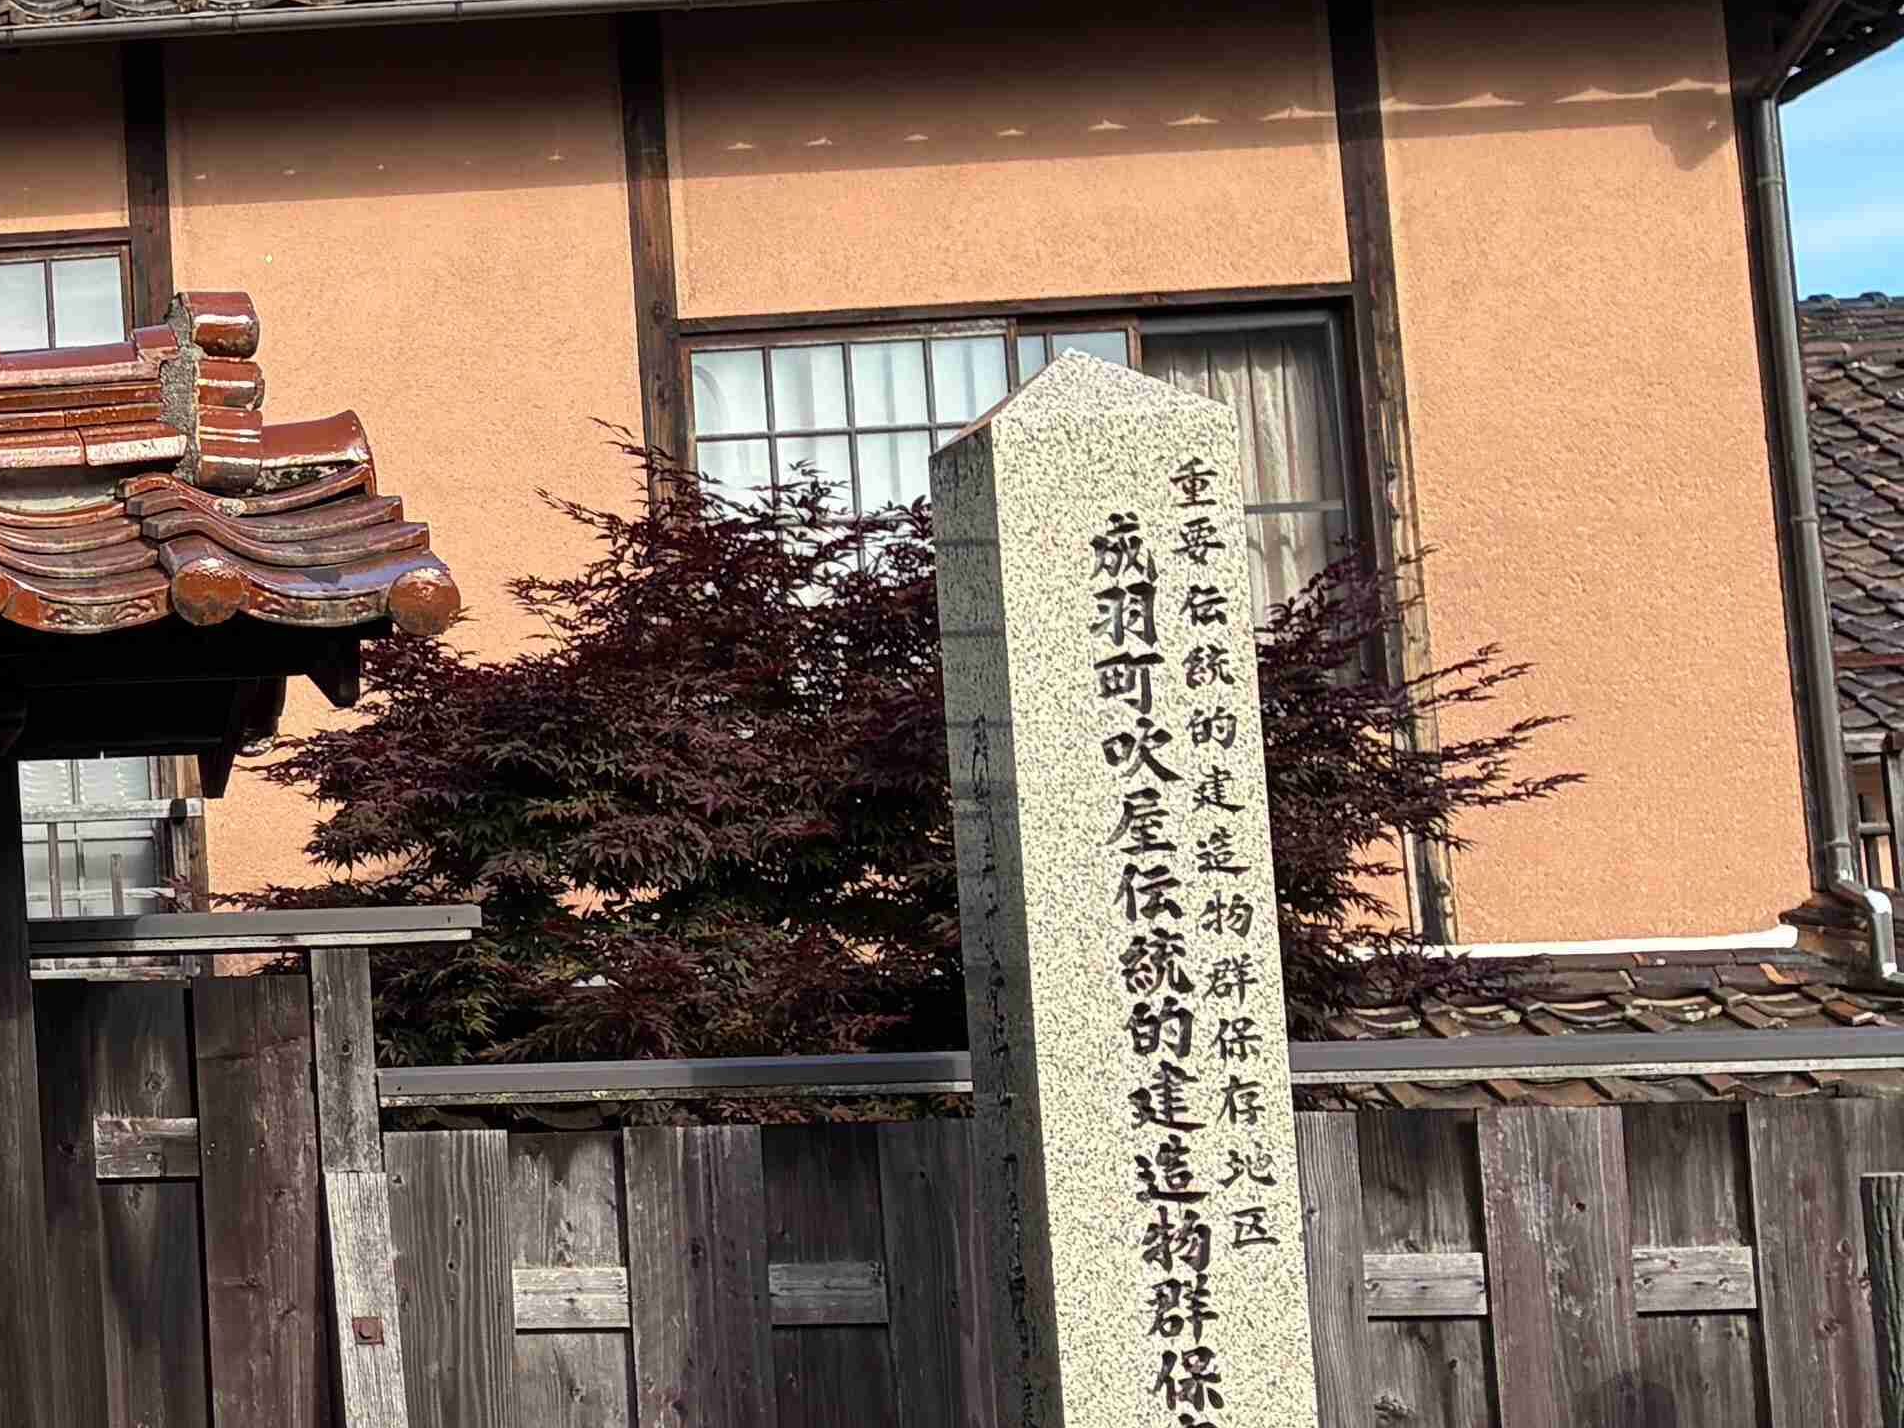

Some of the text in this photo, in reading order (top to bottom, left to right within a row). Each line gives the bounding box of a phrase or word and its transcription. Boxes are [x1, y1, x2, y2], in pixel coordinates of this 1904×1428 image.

[1169, 455, 1279, 1252] 重要伝統的建造物群保存地区
